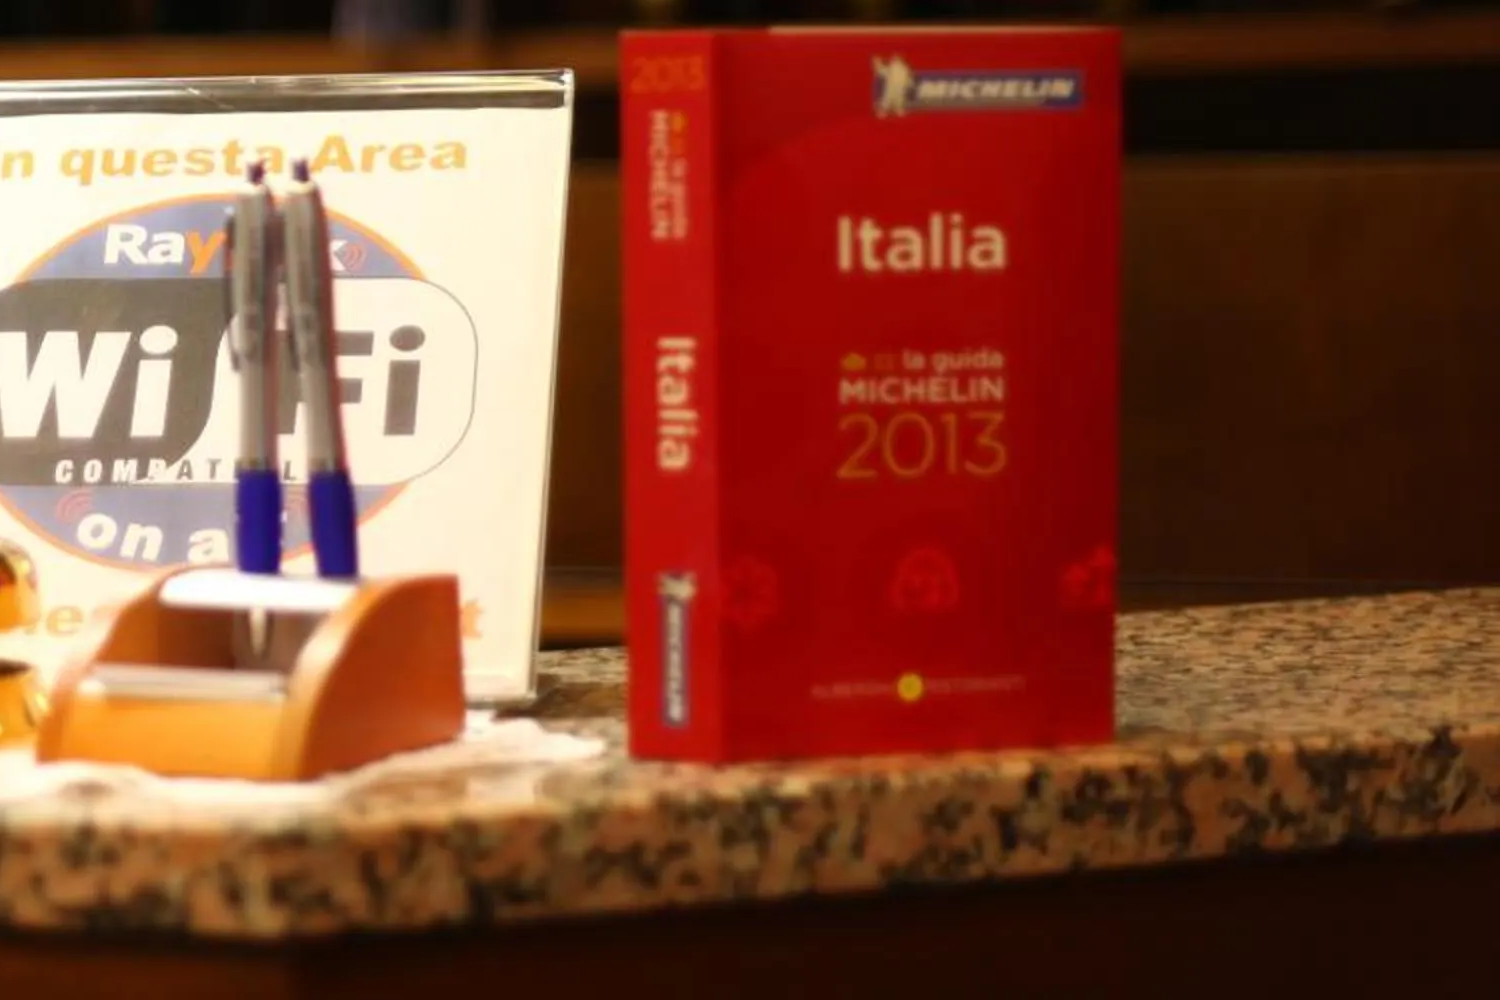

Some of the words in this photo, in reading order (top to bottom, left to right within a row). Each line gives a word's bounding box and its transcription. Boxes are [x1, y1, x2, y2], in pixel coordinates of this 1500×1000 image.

[915, 77, 1076, 100] MICHELIN
[60, 138, 287, 186] questa
[310, 134, 468, 175] Area
[837, 213, 1008, 272] Italia
[656, 336, 697, 470] Italia
[838, 375, 1005, 405] MICHELIN
[836, 410, 1008, 479] 2013
[77, 512, 164, 561] on
